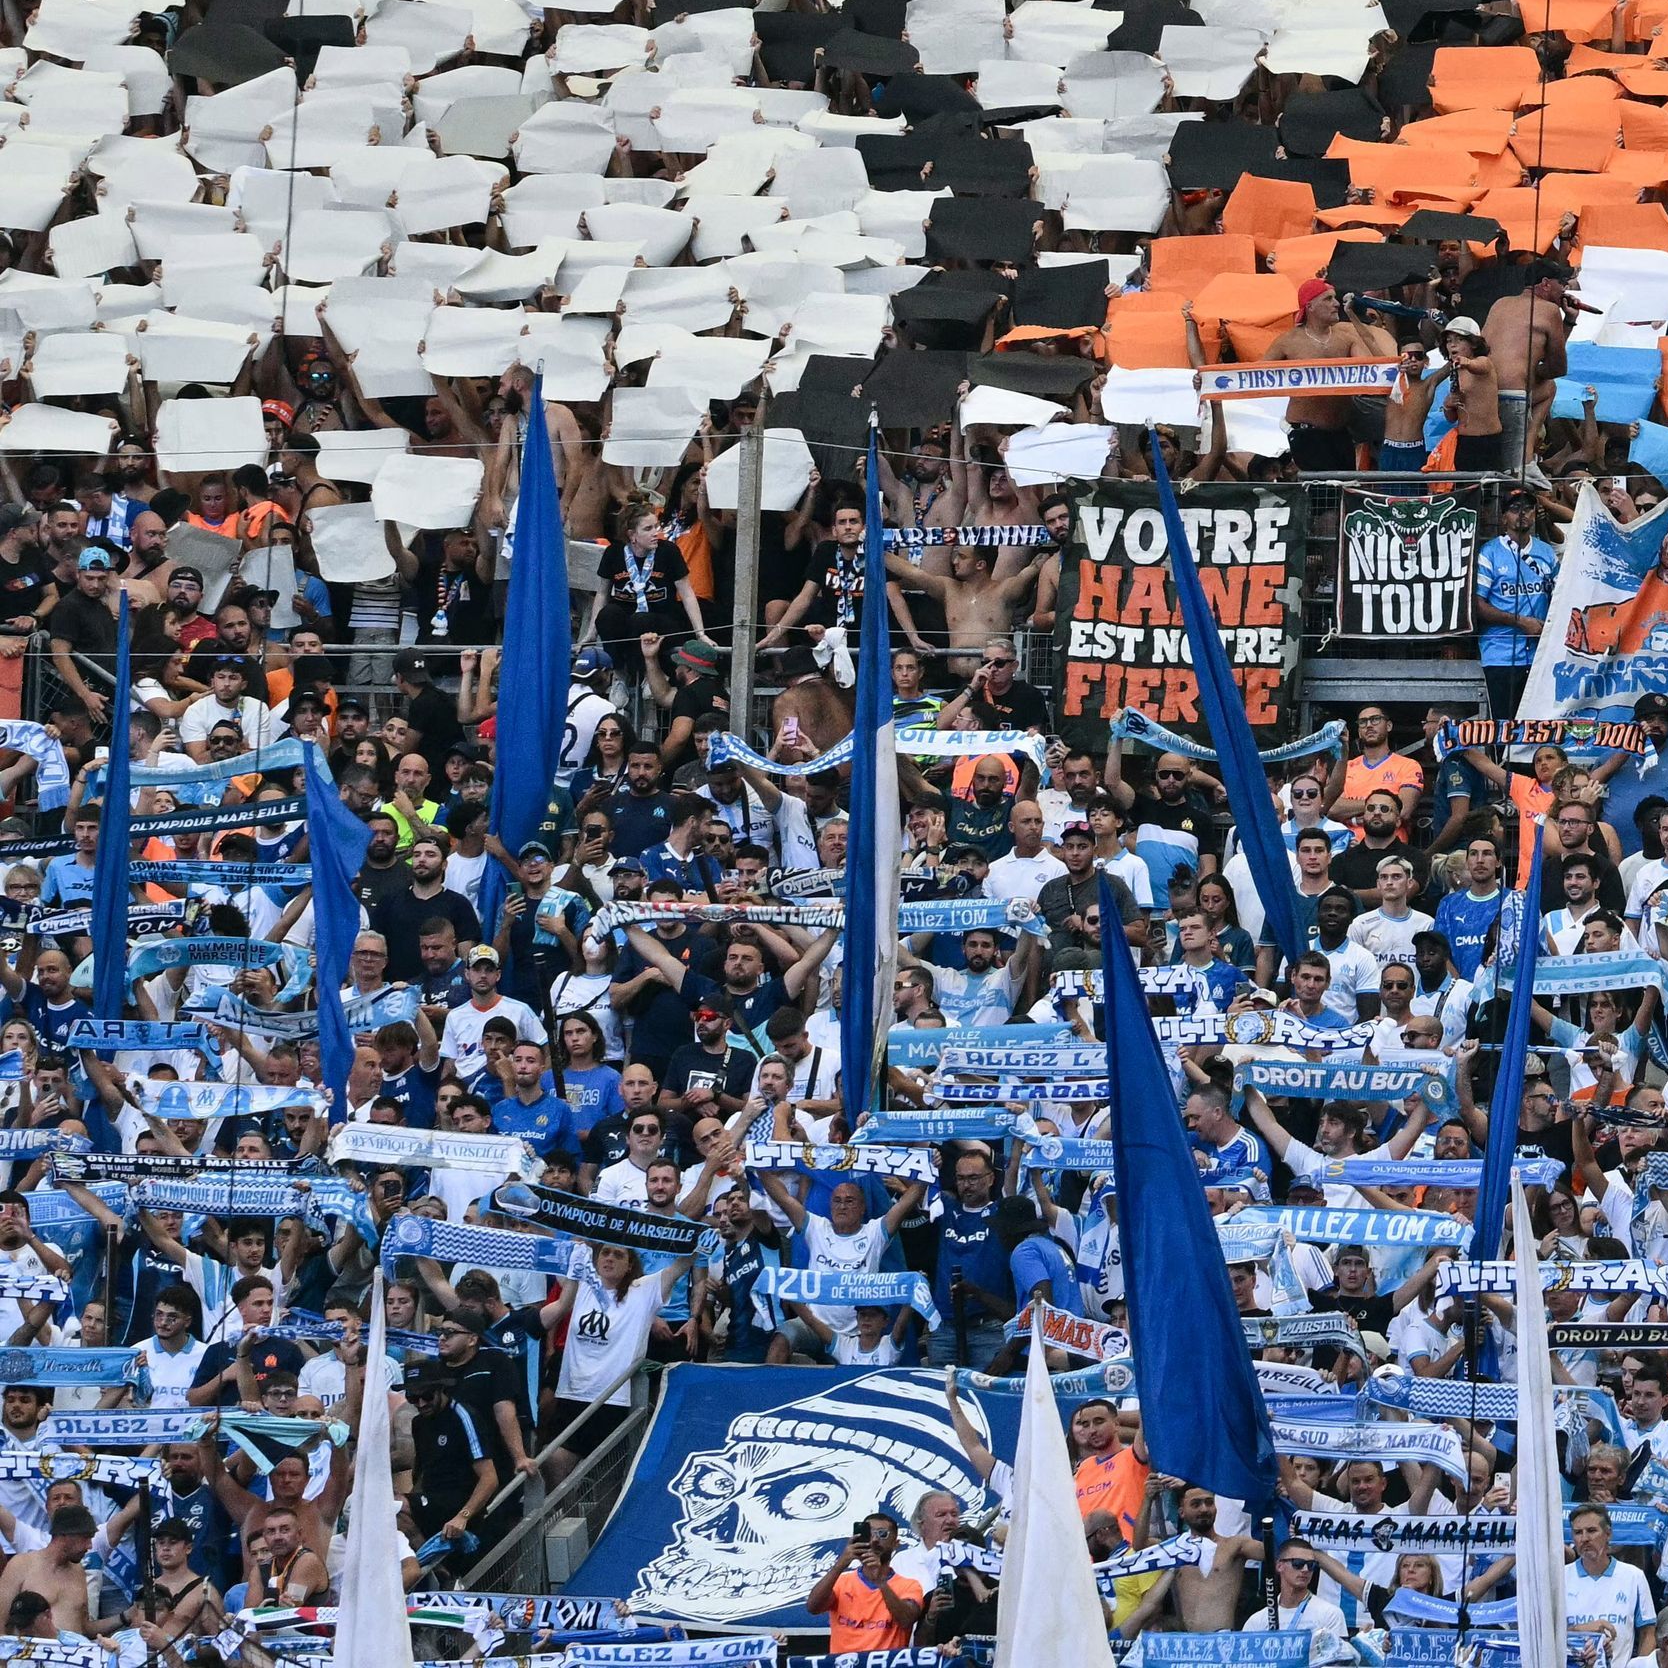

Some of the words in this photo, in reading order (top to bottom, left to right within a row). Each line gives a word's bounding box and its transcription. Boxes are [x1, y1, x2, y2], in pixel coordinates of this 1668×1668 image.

[1238, 368, 1286, 390] FIRST
[1305, 365, 1378, 386] WINNERS
[1079, 506, 1290, 564] VOTRE
[1350, 580, 1464, 633] TOUT
[1067, 620, 1144, 663] EST
[131, 813, 213, 833] OLYMPIQUE
[217, 801, 299, 824] MARSEILLE
[187, 943, 267, 955] OLYMPIQUE
[188, 952, 267, 965] MARSEILLE
[946, 1030, 981, 1040] ALLEZ
[1252, 1065, 1327, 1089] DROIT
[1330, 1070, 1366, 1090] AU
[1371, 1072, 1423, 1092] BUT
[919, 1120, 955, 1134] 1993
[88, 1155, 179, 1167] OLYMPIQUE
[180, 1158, 203, 1168] DE
[541, 1199, 608, 1228] OLYMPIQUE
[610, 1216, 626, 1230] DE
[628, 1220, 695, 1243] MARSEILLE
[1277, 1210, 1356, 1238] ALLEZ
[1364, 1212, 1429, 1242] L'OM
[840, 1272, 901, 1286] OLYMPIQUE
[831, 1284, 850, 1297] DE
[852, 1284, 908, 1298] MARSEILLE
[1556, 1323, 1613, 1343] DROIT
[1616, 1323, 1645, 1341] AU
